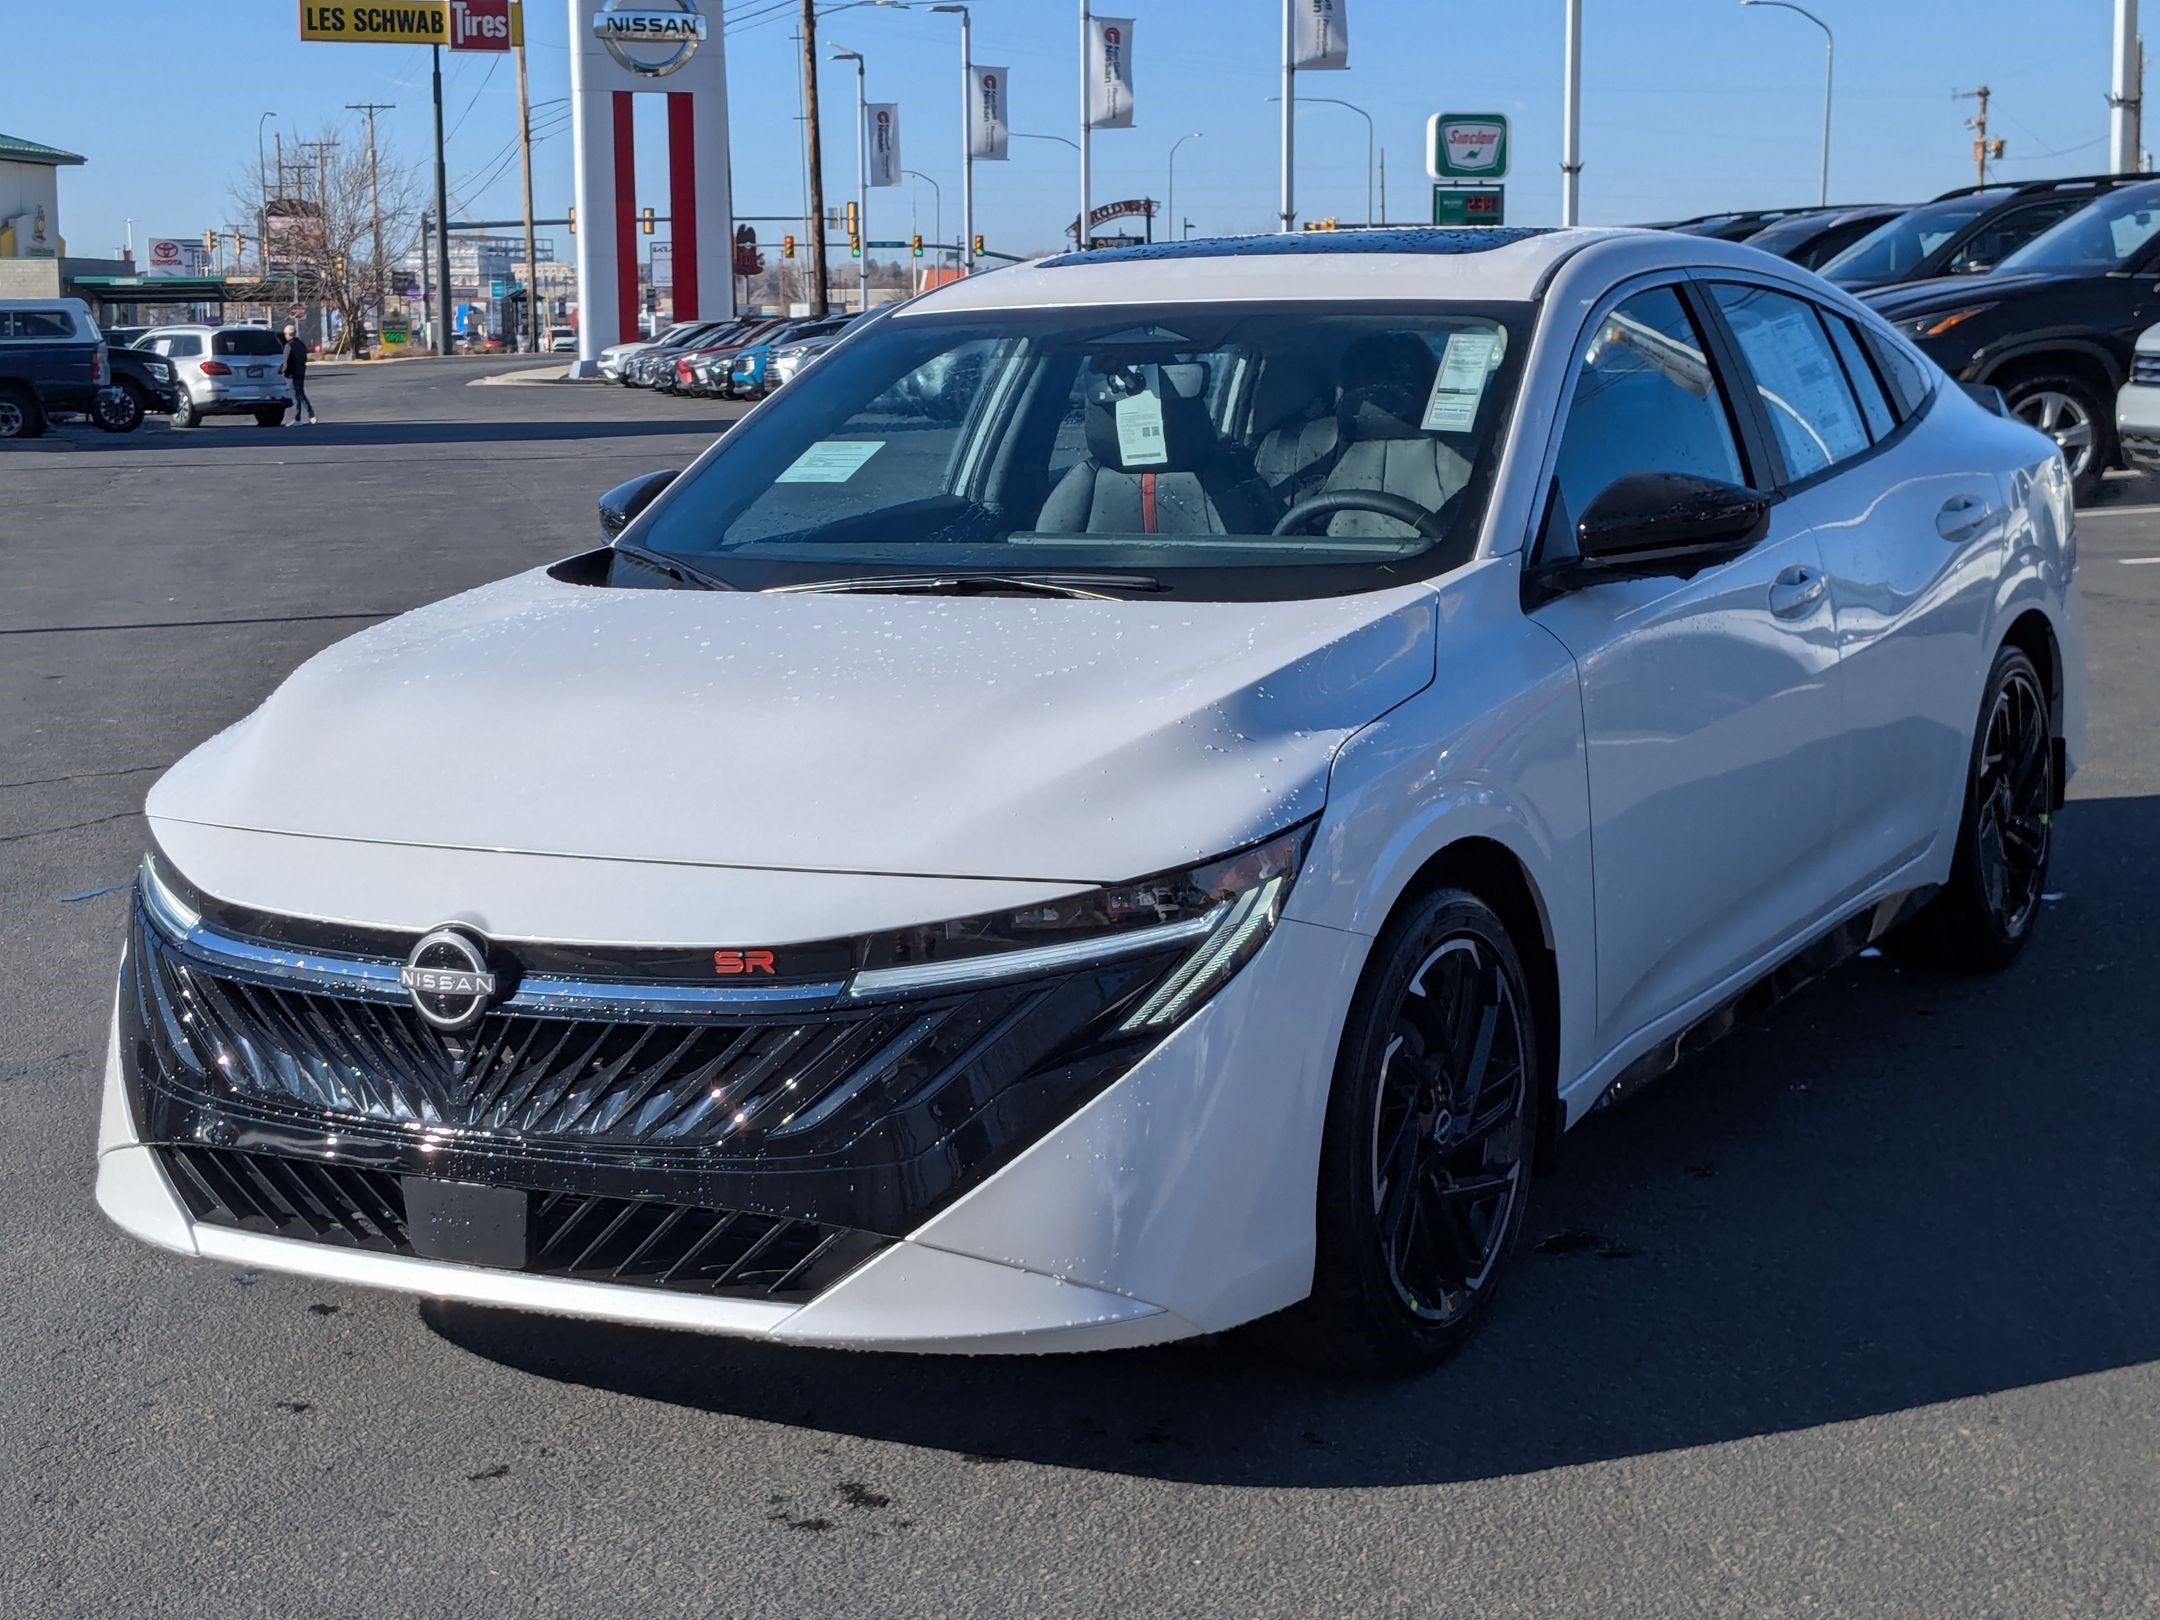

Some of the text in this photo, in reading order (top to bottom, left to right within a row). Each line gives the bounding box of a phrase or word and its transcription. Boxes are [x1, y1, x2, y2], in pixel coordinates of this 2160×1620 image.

[306, 7, 444, 34] LES SCHWAB
[452, 1, 507, 44] Tires
[606, 17, 696, 33] NISSAN
[1104, 45, 1113, 83] Nissan
[1449, 129, 1497, 145] Sinclair
[714, 950, 775, 974] SR
[401, 970, 493, 993] NISSAN
